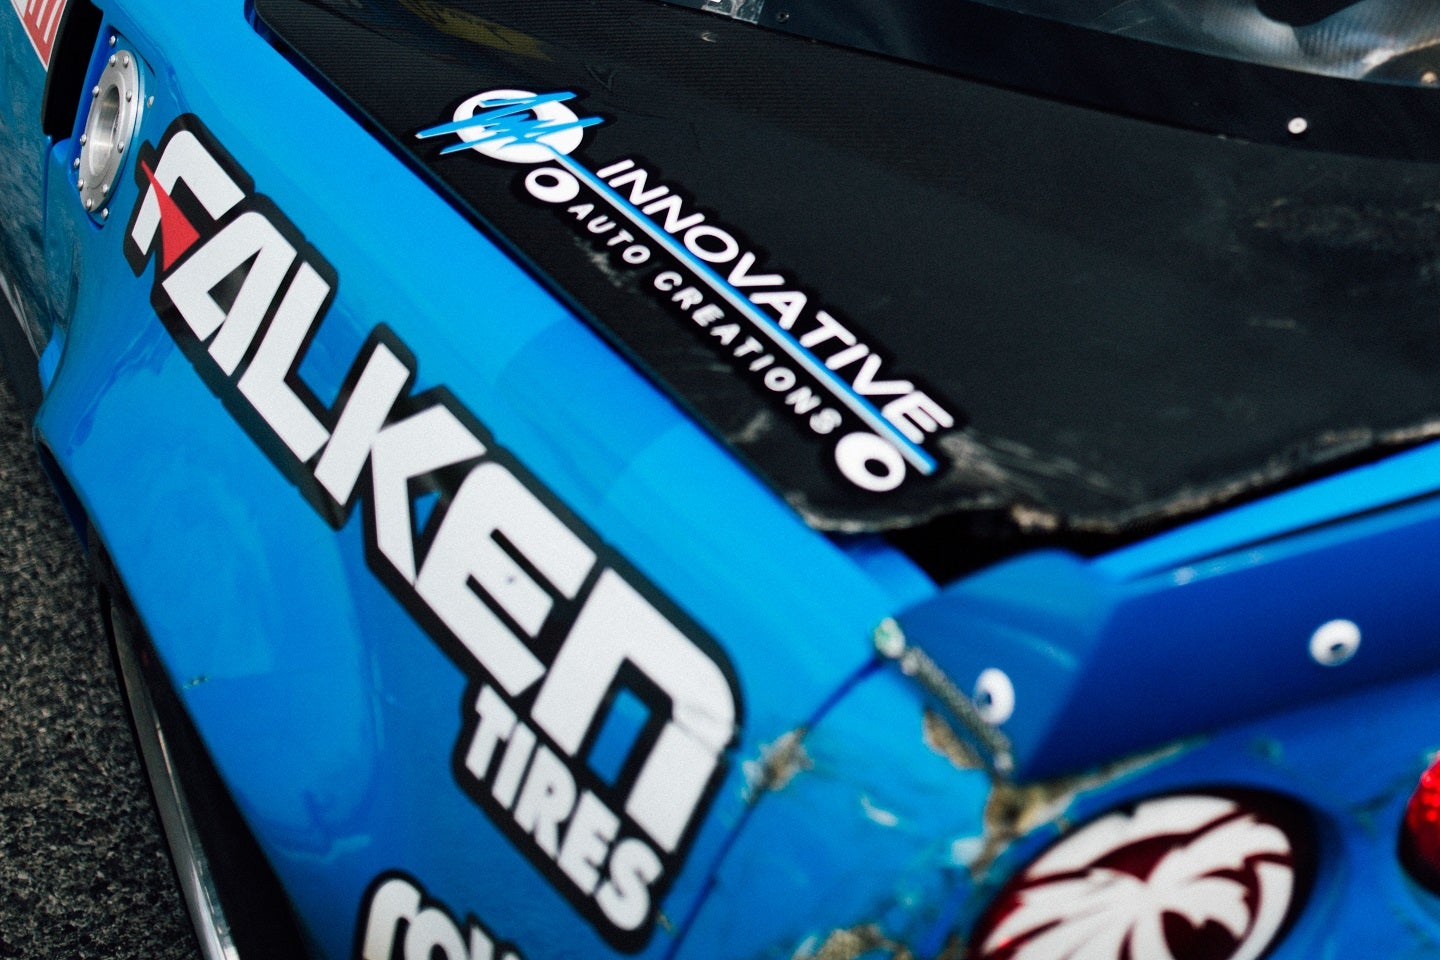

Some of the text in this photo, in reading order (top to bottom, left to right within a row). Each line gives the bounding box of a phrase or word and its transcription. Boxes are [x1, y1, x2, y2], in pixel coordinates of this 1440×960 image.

[567, 203, 842, 434] AUTO CREATIONS
[595, 159, 955, 444] INNOVATIVE
[131, 129, 737, 853] FALKEN
[465, 686, 665, 932] TIRES
